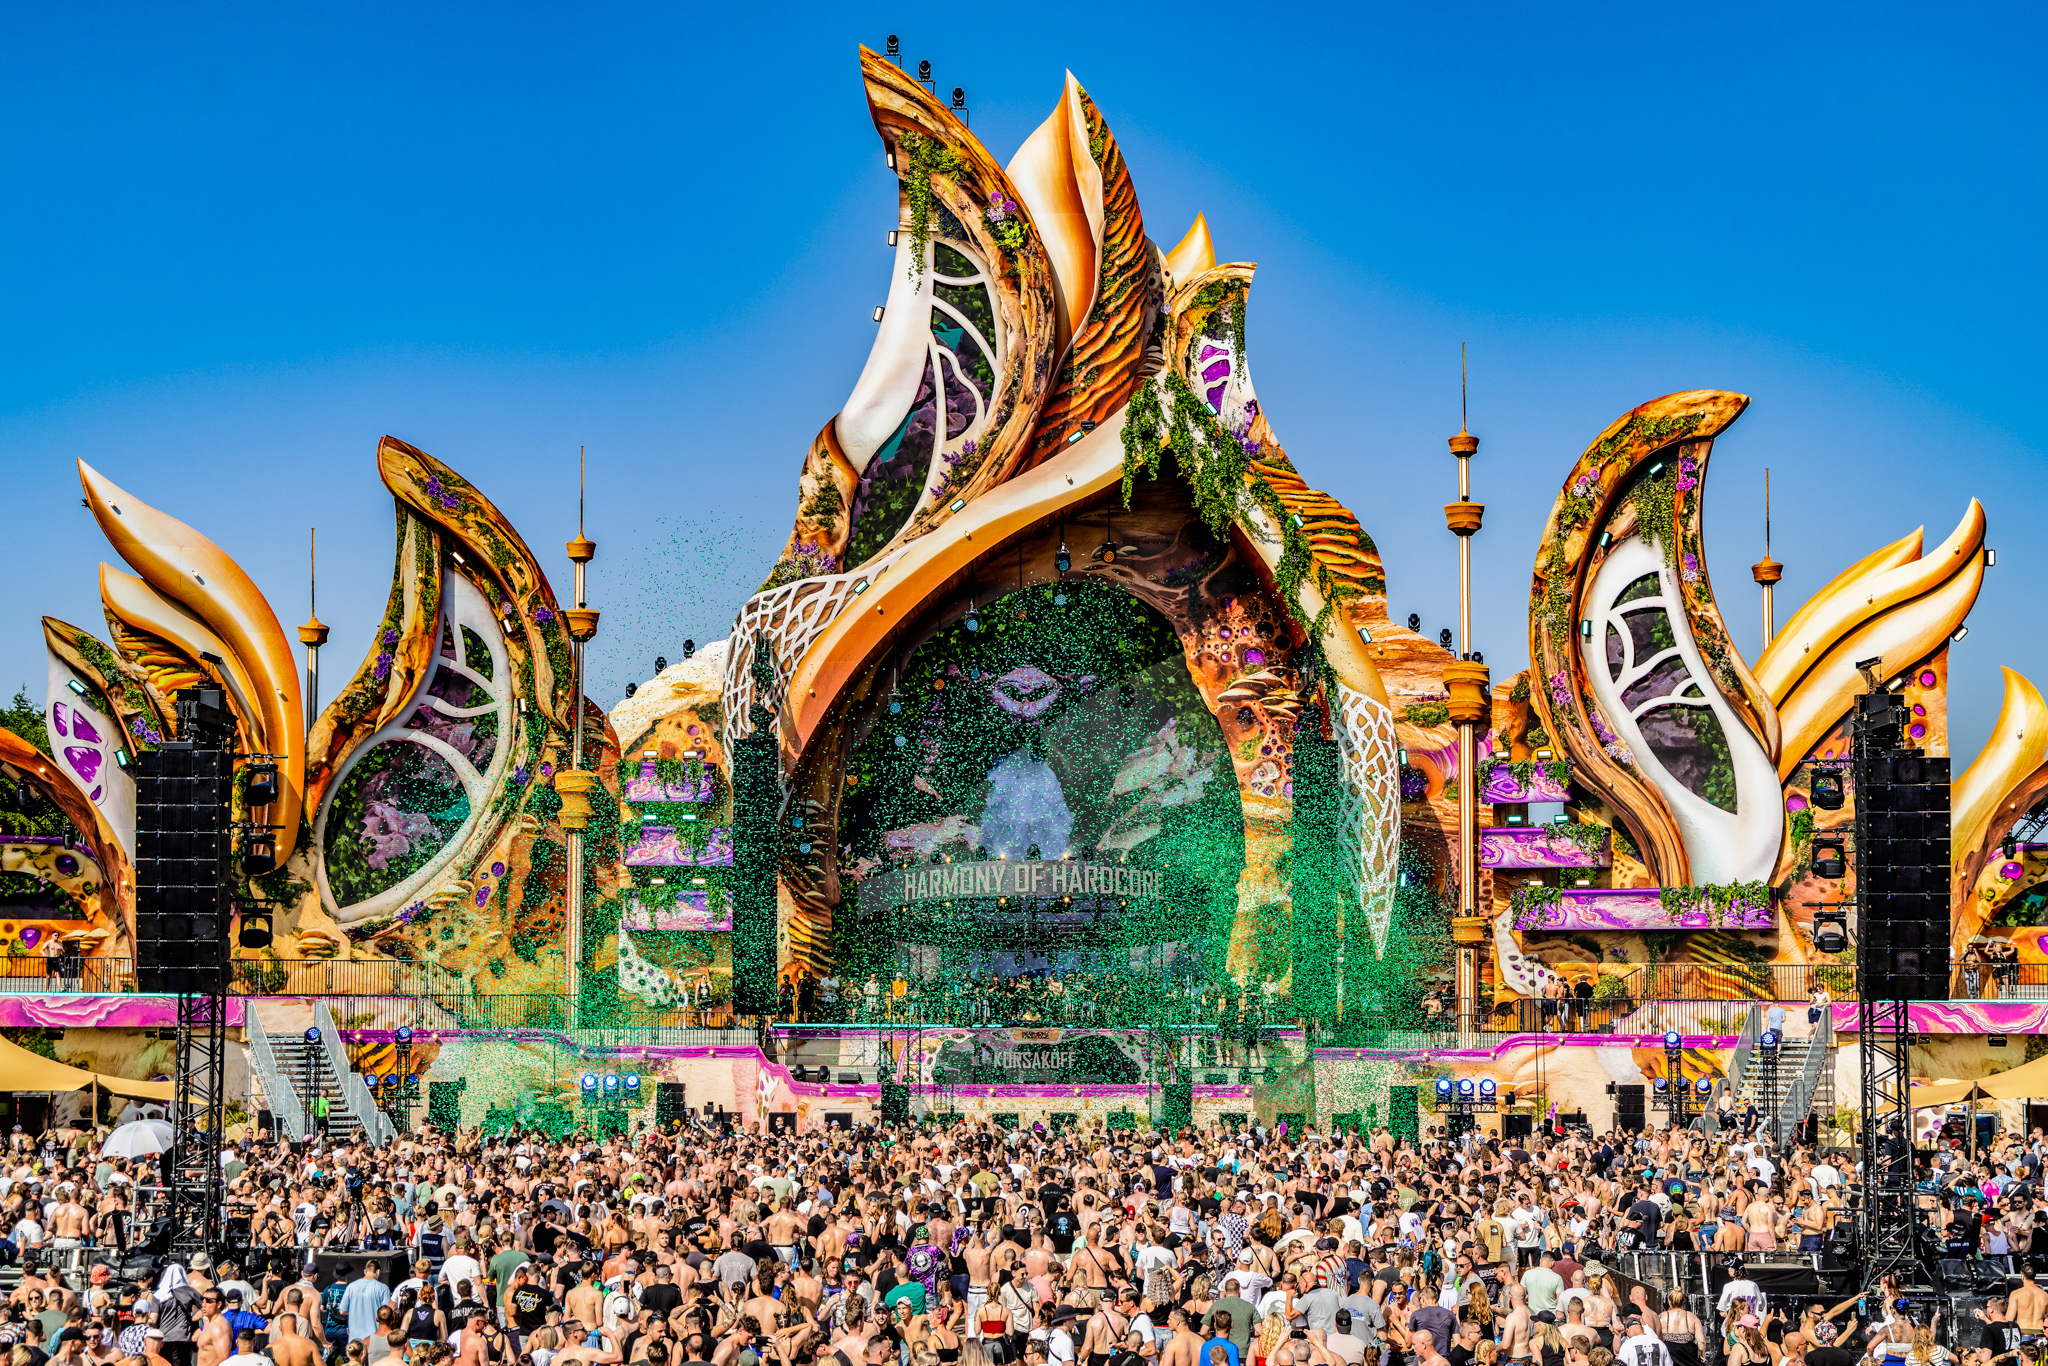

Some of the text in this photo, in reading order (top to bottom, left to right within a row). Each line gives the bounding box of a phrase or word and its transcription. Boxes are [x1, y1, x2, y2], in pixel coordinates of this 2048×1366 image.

[904, 864, 1165, 901] HARMONY OF HARDCORE
[993, 1051, 1077, 1069] KORSAKOFF
